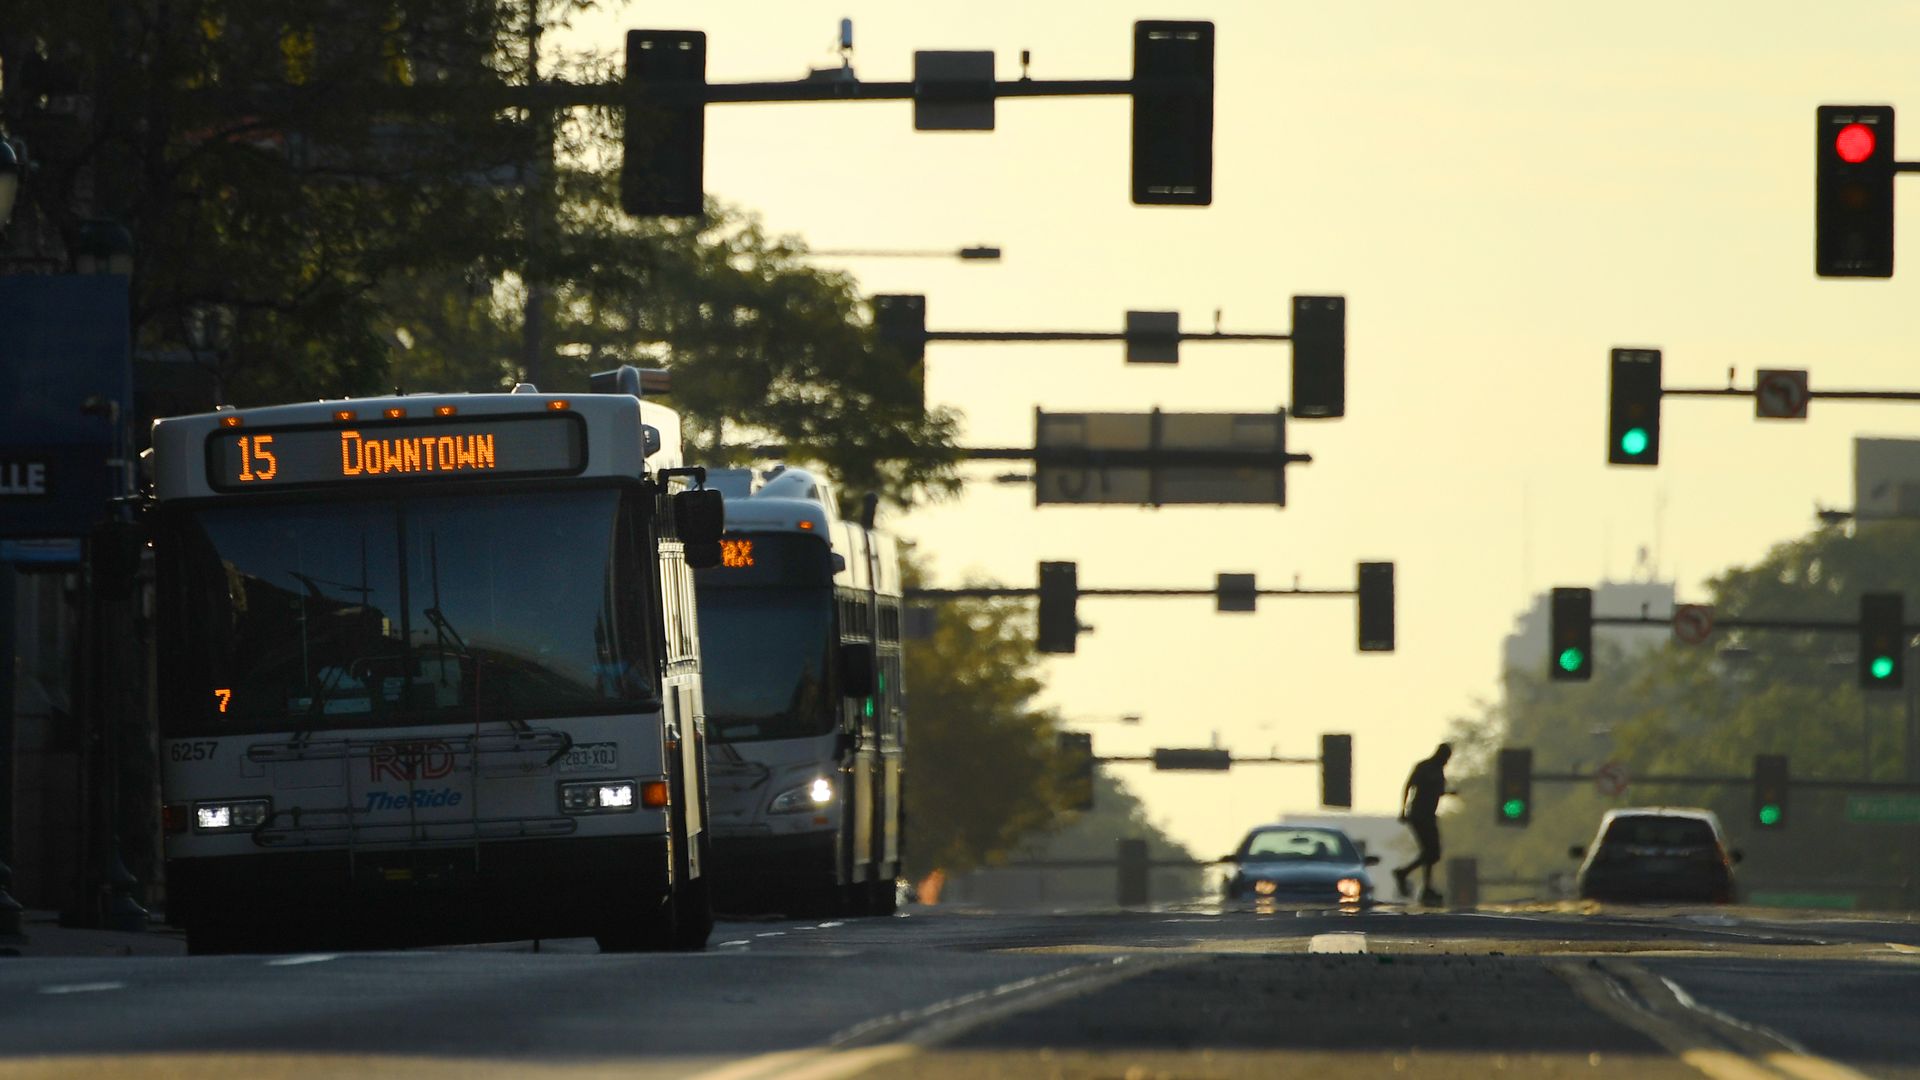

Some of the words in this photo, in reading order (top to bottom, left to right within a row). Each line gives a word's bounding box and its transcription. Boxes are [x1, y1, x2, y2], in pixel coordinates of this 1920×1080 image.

[238, 434, 277, 481] 15
[341, 430, 495, 475] DOWNTOWN
[720, 539, 753, 567] AX
[214, 688, 231, 712] 7
[171, 741, 219, 761] 6257
